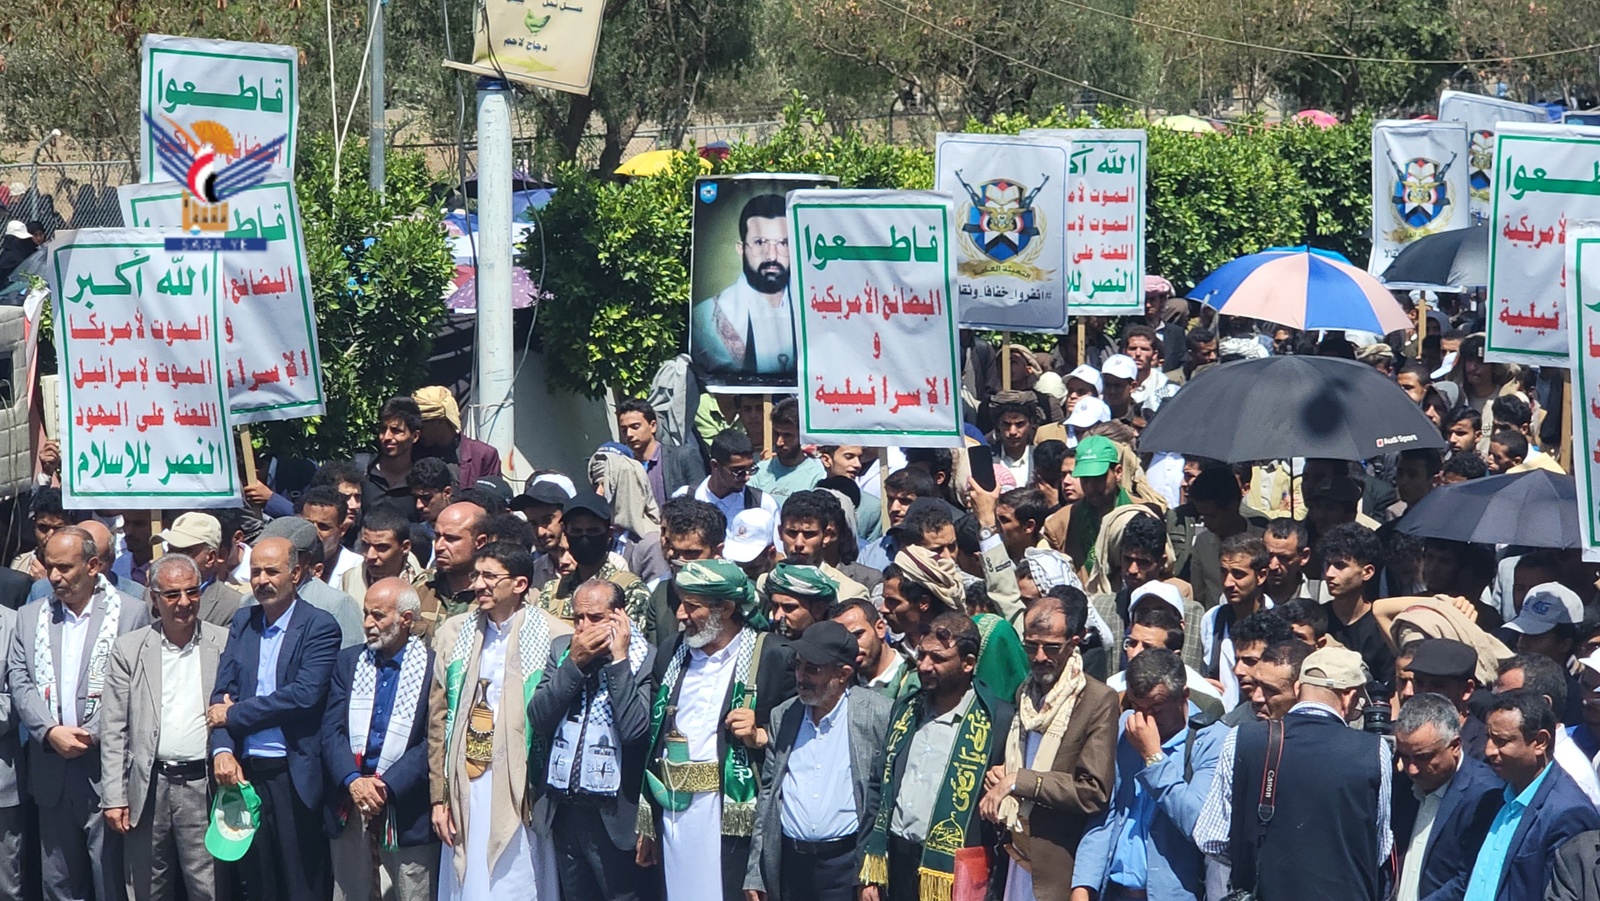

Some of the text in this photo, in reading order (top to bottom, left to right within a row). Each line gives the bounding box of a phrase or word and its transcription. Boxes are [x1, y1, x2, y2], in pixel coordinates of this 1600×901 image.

[158, 69, 284, 114] قاطعوا
[1097, 148, 1135, 174] الله
[1090, 186, 1134, 206] الموت
[1090, 215, 1134, 235] الموت
[804, 224, 939, 270] قاطعوا
[1073, 243, 1134, 264] اللعنة على
[65, 250, 151, 310] أكبر
[156, 255, 209, 297] الله
[1086, 267, 1133, 299] النصر
[810, 280, 942, 321] البضائع الأمريكية
[69, 306, 209, 347] الموت لأمريكا
[873, 332, 881, 359] و
[73, 356, 212, 390] الموت لإسرائيل
[814, 375, 950, 414] الإسرائيلية
[75, 400, 129, 433] اليهود
[136, 400, 165, 432] على
[173, 400, 218, 427] اللعنة
[77, 436, 223, 488] النصر للإسلام
[1265, 770, 1274, 798] Canon
